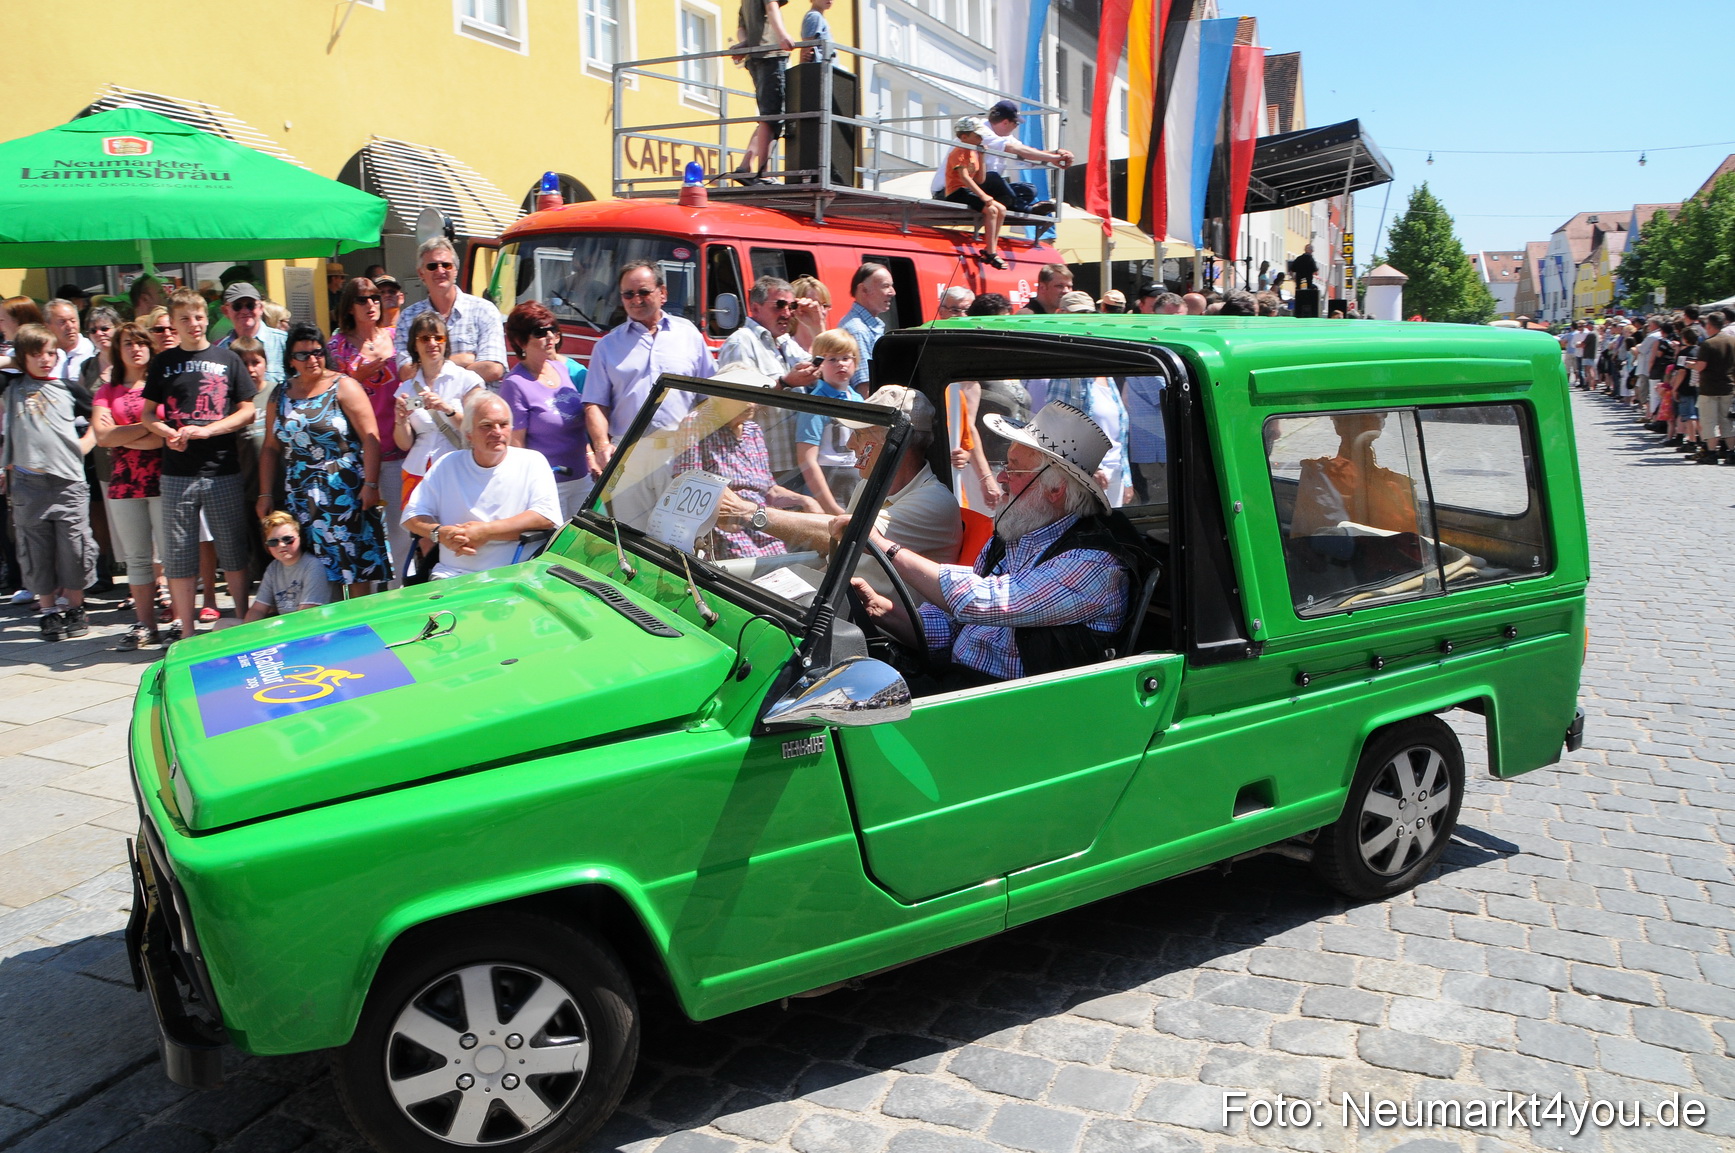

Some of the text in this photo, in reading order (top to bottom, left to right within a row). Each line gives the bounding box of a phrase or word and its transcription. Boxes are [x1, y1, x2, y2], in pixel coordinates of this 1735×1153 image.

[21, 167, 232, 181] Lammsbräu
[53, 159, 204, 169] Neumarkter
[1343, 233, 1354, 289] HOTEL
[676, 486, 712, 516] 209
[782, 735, 827, 759] RENAULT
